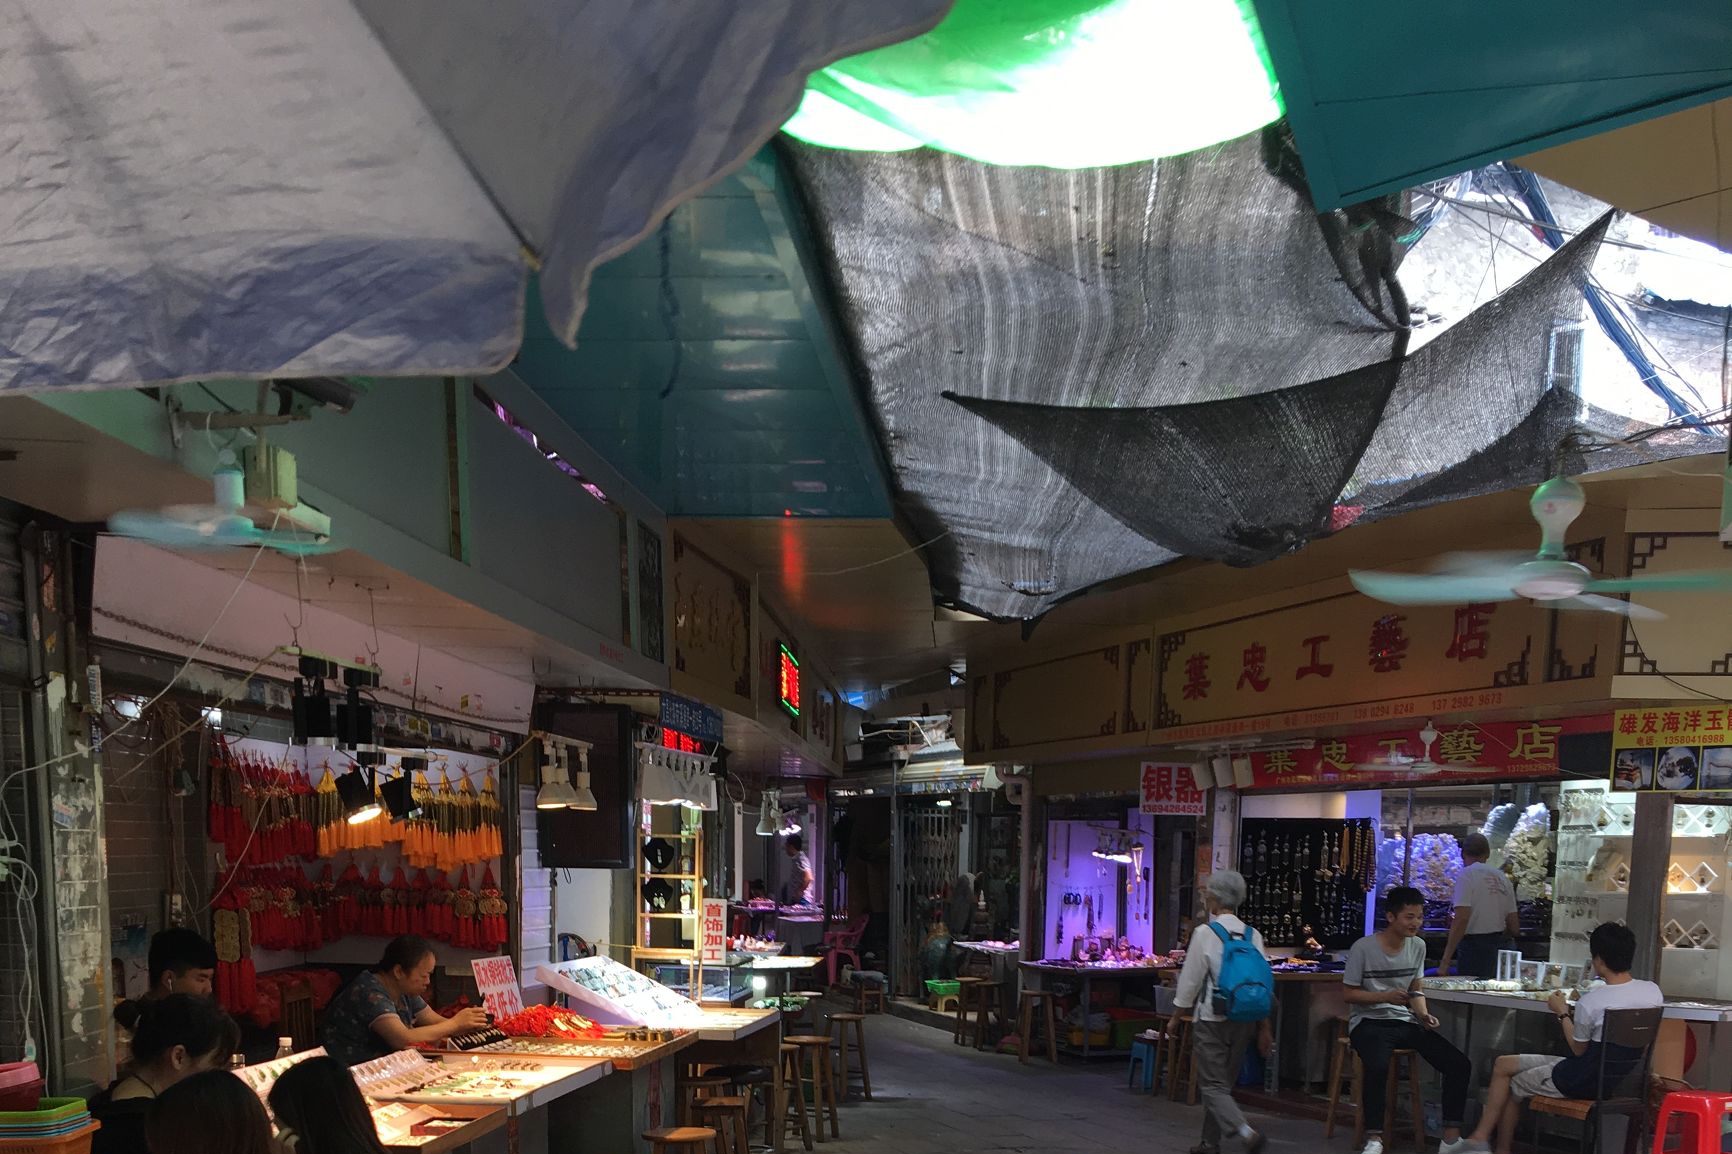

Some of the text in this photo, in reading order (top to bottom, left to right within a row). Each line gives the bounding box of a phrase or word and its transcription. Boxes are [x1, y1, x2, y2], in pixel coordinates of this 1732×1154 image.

[1619, 708, 1732, 735] 雄发海洋玉
[704, 903, 723, 960] 首饰加工
